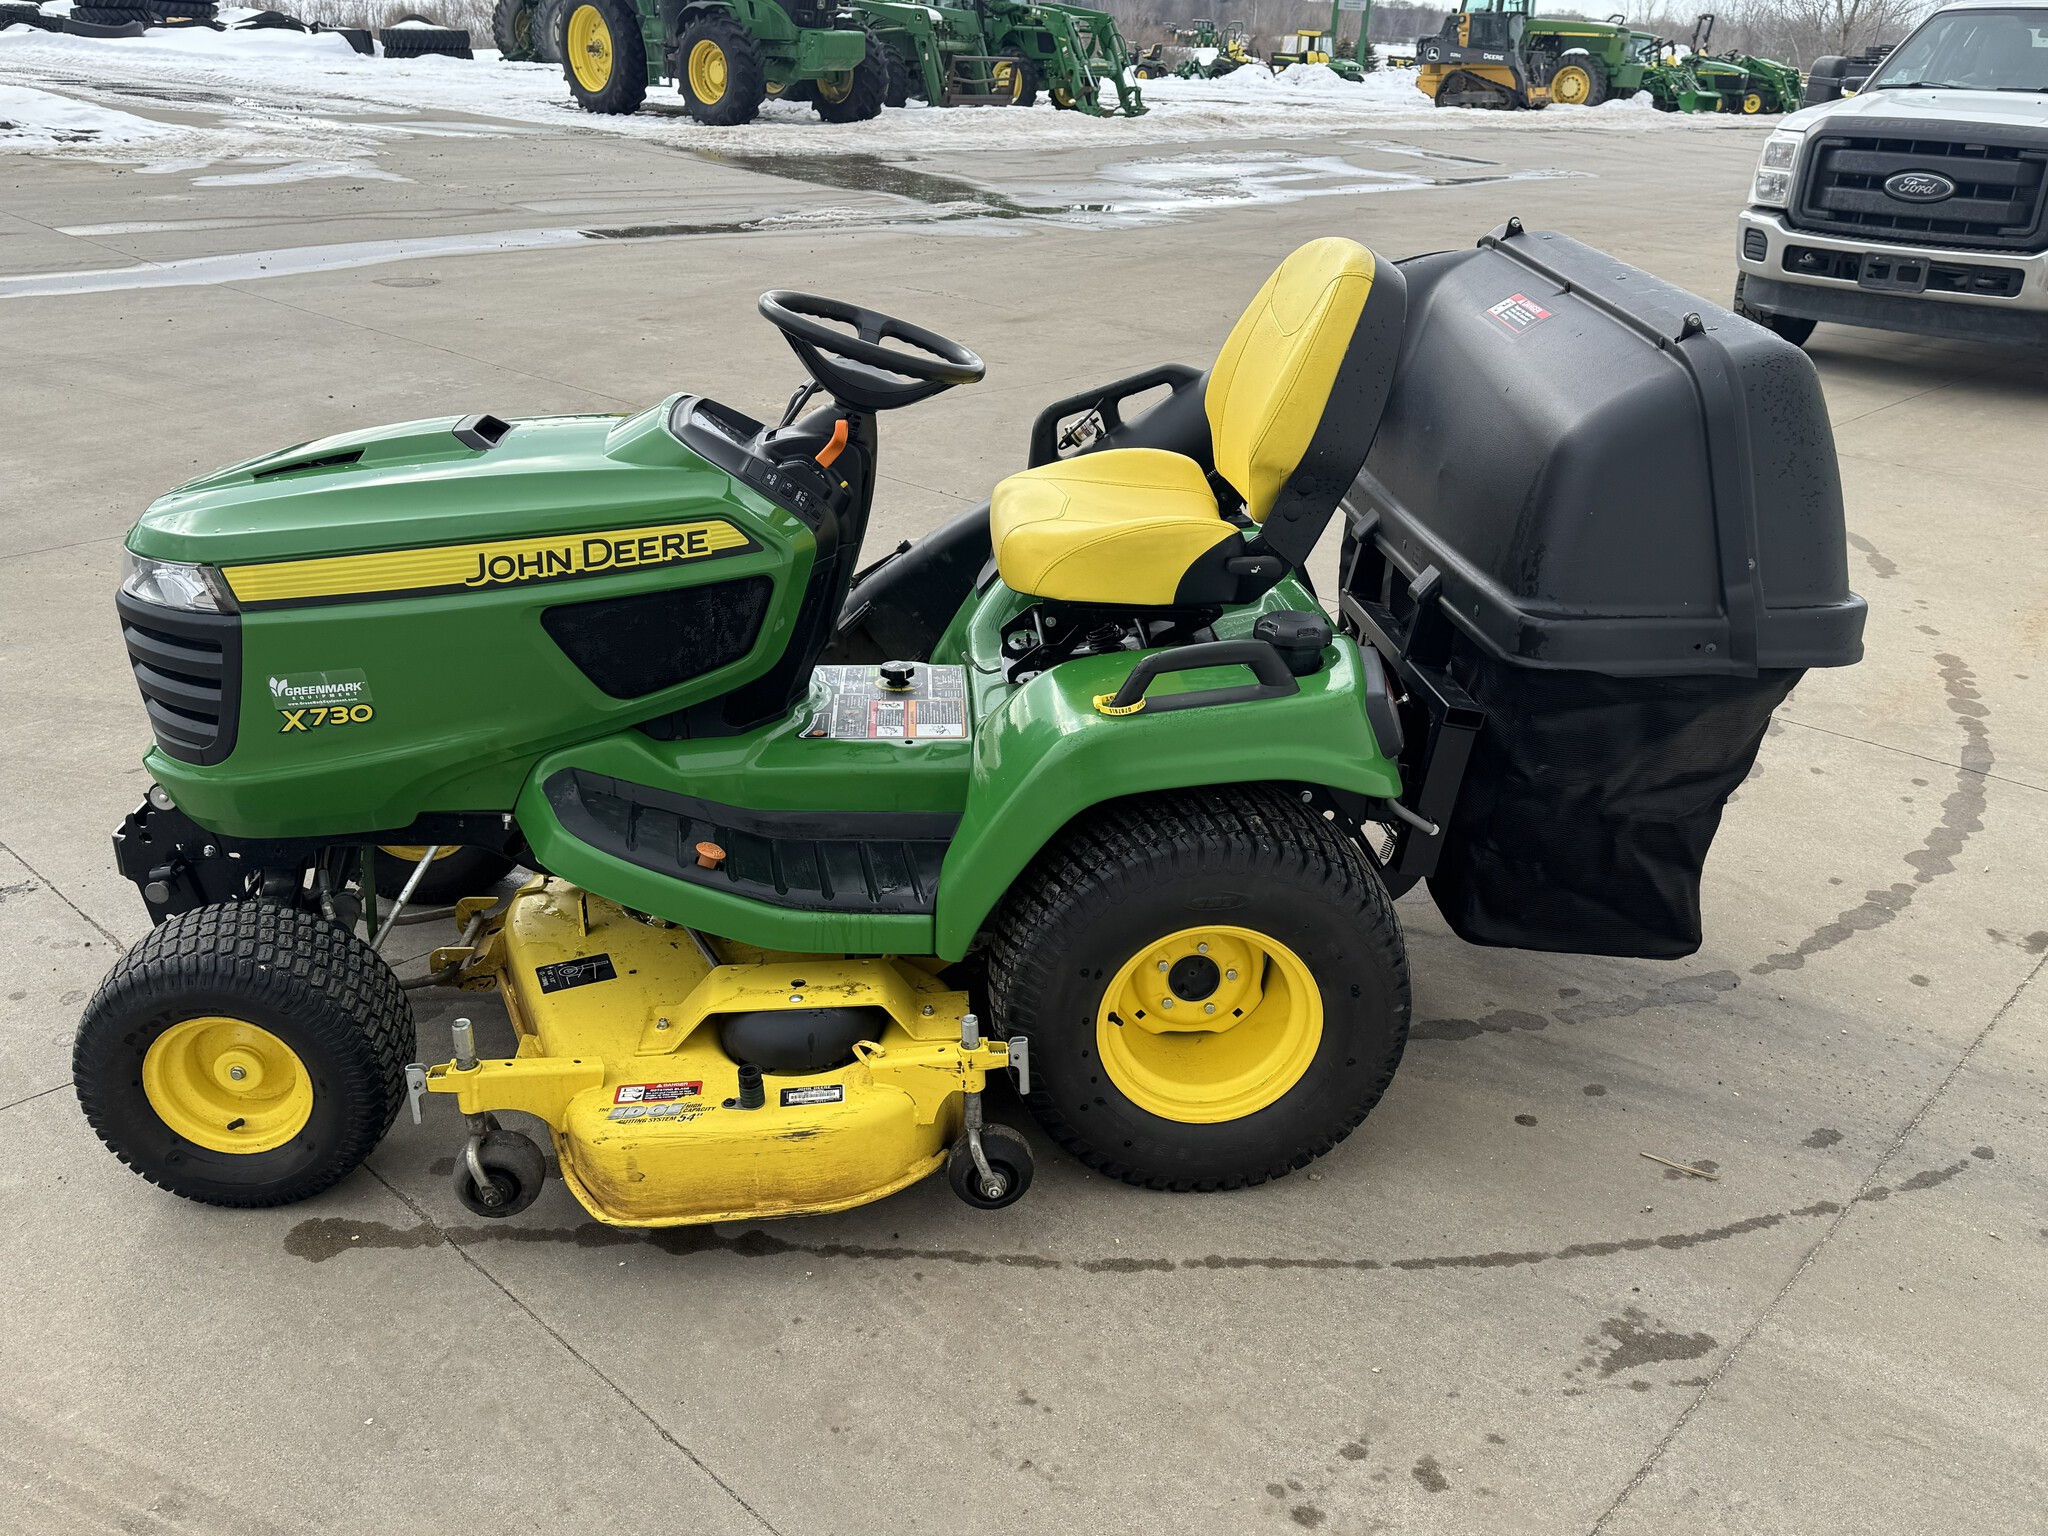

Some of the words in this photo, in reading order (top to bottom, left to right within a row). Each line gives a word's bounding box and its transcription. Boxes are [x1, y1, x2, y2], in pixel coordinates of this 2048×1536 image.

[1483, 52, 1504, 61] DEERE
[1851, 119, 1940, 131] SUPER
[1953, 124, 2035, 137] DUTY
[1898, 176, 1937, 195] Ford
[465, 552, 572, 583] JOHN
[582, 529, 709, 568] DEERE
[285, 682, 362, 696] GREENMARK
[292, 691, 358, 701] EQUIPMENT
[280, 704, 373, 732] X730
[605, 1103, 687, 1120] EDGE
